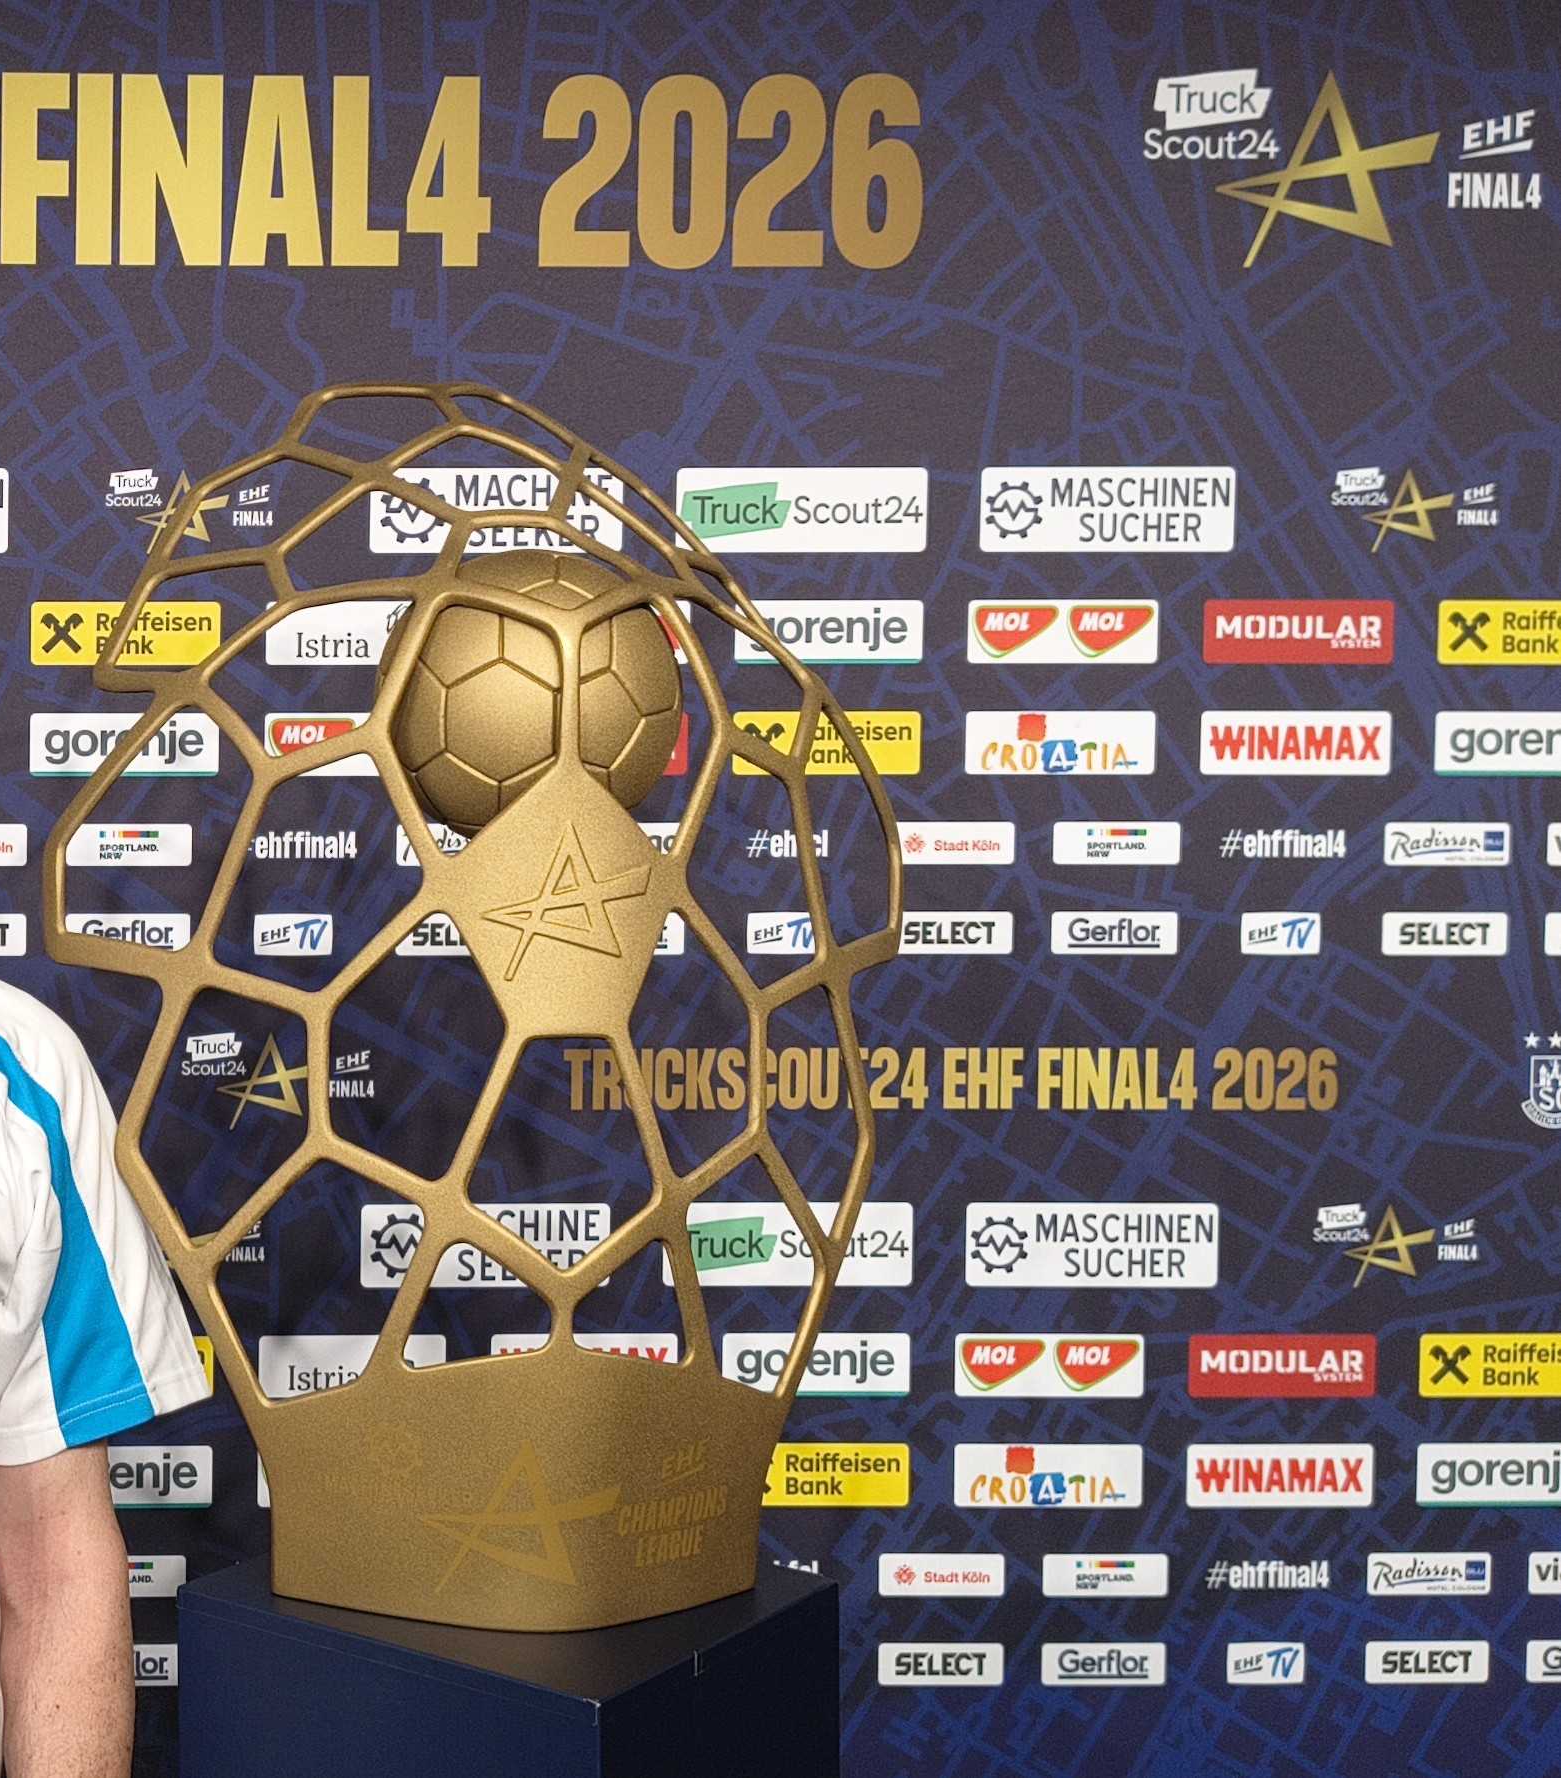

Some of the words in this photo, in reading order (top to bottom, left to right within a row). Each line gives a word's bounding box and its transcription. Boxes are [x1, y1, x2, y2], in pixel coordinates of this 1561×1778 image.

[1167, 83, 1257, 114] Truck
[1462, 109, 1536, 148] EHF
[1143, 128, 1279, 160] Scout24
[0, 71, 492, 267] FINAL4
[537, 73, 925, 270] 2026
[1448, 172, 1541, 209] FINAL4
[116, 474, 154, 488] Truck
[238, 484, 270, 501] EHF
[1050, 477, 1231, 508] MASCHINEN
[1462, 484, 1498, 501] EHF
[105, 492, 163, 507] Scout24
[693, 496, 779, 525] Truck
[793, 496, 923, 525] Scout24
[232, 510, 274, 526] FINAL4
[1079, 513, 1201, 543] SUCHER
[1456, 510, 1498, 526] FINAL4
[984, 612, 1030, 632] MOL
[1078, 612, 1124, 632] MOL
[1215, 615, 1382, 640] MODULAR
[296, 631, 370, 659] Istria
[1331, 639, 1382, 648] SYSTEM
[1503, 634, 1559, 654] Bank
[1209, 726, 1382, 760] WINAMAX
[981, 742, 1138, 772] CROATIA
[934, 840, 967, 852] Stadt
[967, 839, 1000, 853] Köln
[1087, 850, 1110, 858] NRW
[1220, 829, 1345, 858] #ehffinal4
[1391, 828, 1481, 860] Radisson
[99, 852, 123, 860] NRW
[259, 924, 289, 944] EHF
[293, 918, 325, 950] TV
[753, 924, 783, 944] EHF
[905, 922, 997, 945] SELECT
[1249, 923, 1278, 943] EHF
[1281, 918, 1315, 949] TV
[1399, 923, 1490, 946] SELECT
[193, 1038, 235, 1054] Truck
[181, 1060, 247, 1076] Scout24
[335, 1050, 371, 1070] EHF
[943, 1047, 1024, 1110] EHF
[1038, 1047, 1197, 1110] FINAL4
[1212, 1046, 1339, 1111] 2026
[1035, 1214, 1213, 1242] MASCHINEN
[1313, 1228, 1369, 1243] Scout24
[1443, 1220, 1476, 1237] EHF
[1064, 1250, 1185, 1278] SUCHER
[1438, 1245, 1478, 1261] FINAL4
[971, 1346, 1015, 1365] MOL
[1065, 1346, 1110, 1365] MOL
[1201, 1350, 1364, 1373] MODULAR
[1313, 1373, 1363, 1382] SYSTEM
[1483, 1367, 1538, 1386] Bank
[785, 1453, 901, 1474] Raiffeisen
[785, 1477, 843, 1496] Bank
[1196, 1458, 1363, 1493] WINAMAX
[969, 1474, 1125, 1504] CROATIA
[923, 1571, 957, 1584] Stadt
[959, 1570, 991, 1584] Köln
[1205, 1561, 1330, 1590] #ehffinal4
[1373, 1559, 1463, 1587] Radisson
[894, 1654, 987, 1676] SELECT
[1233, 1653, 1263, 1674] EHF
[1267, 1647, 1300, 1677] TV
[1381, 1651, 1472, 1673] SELECT
